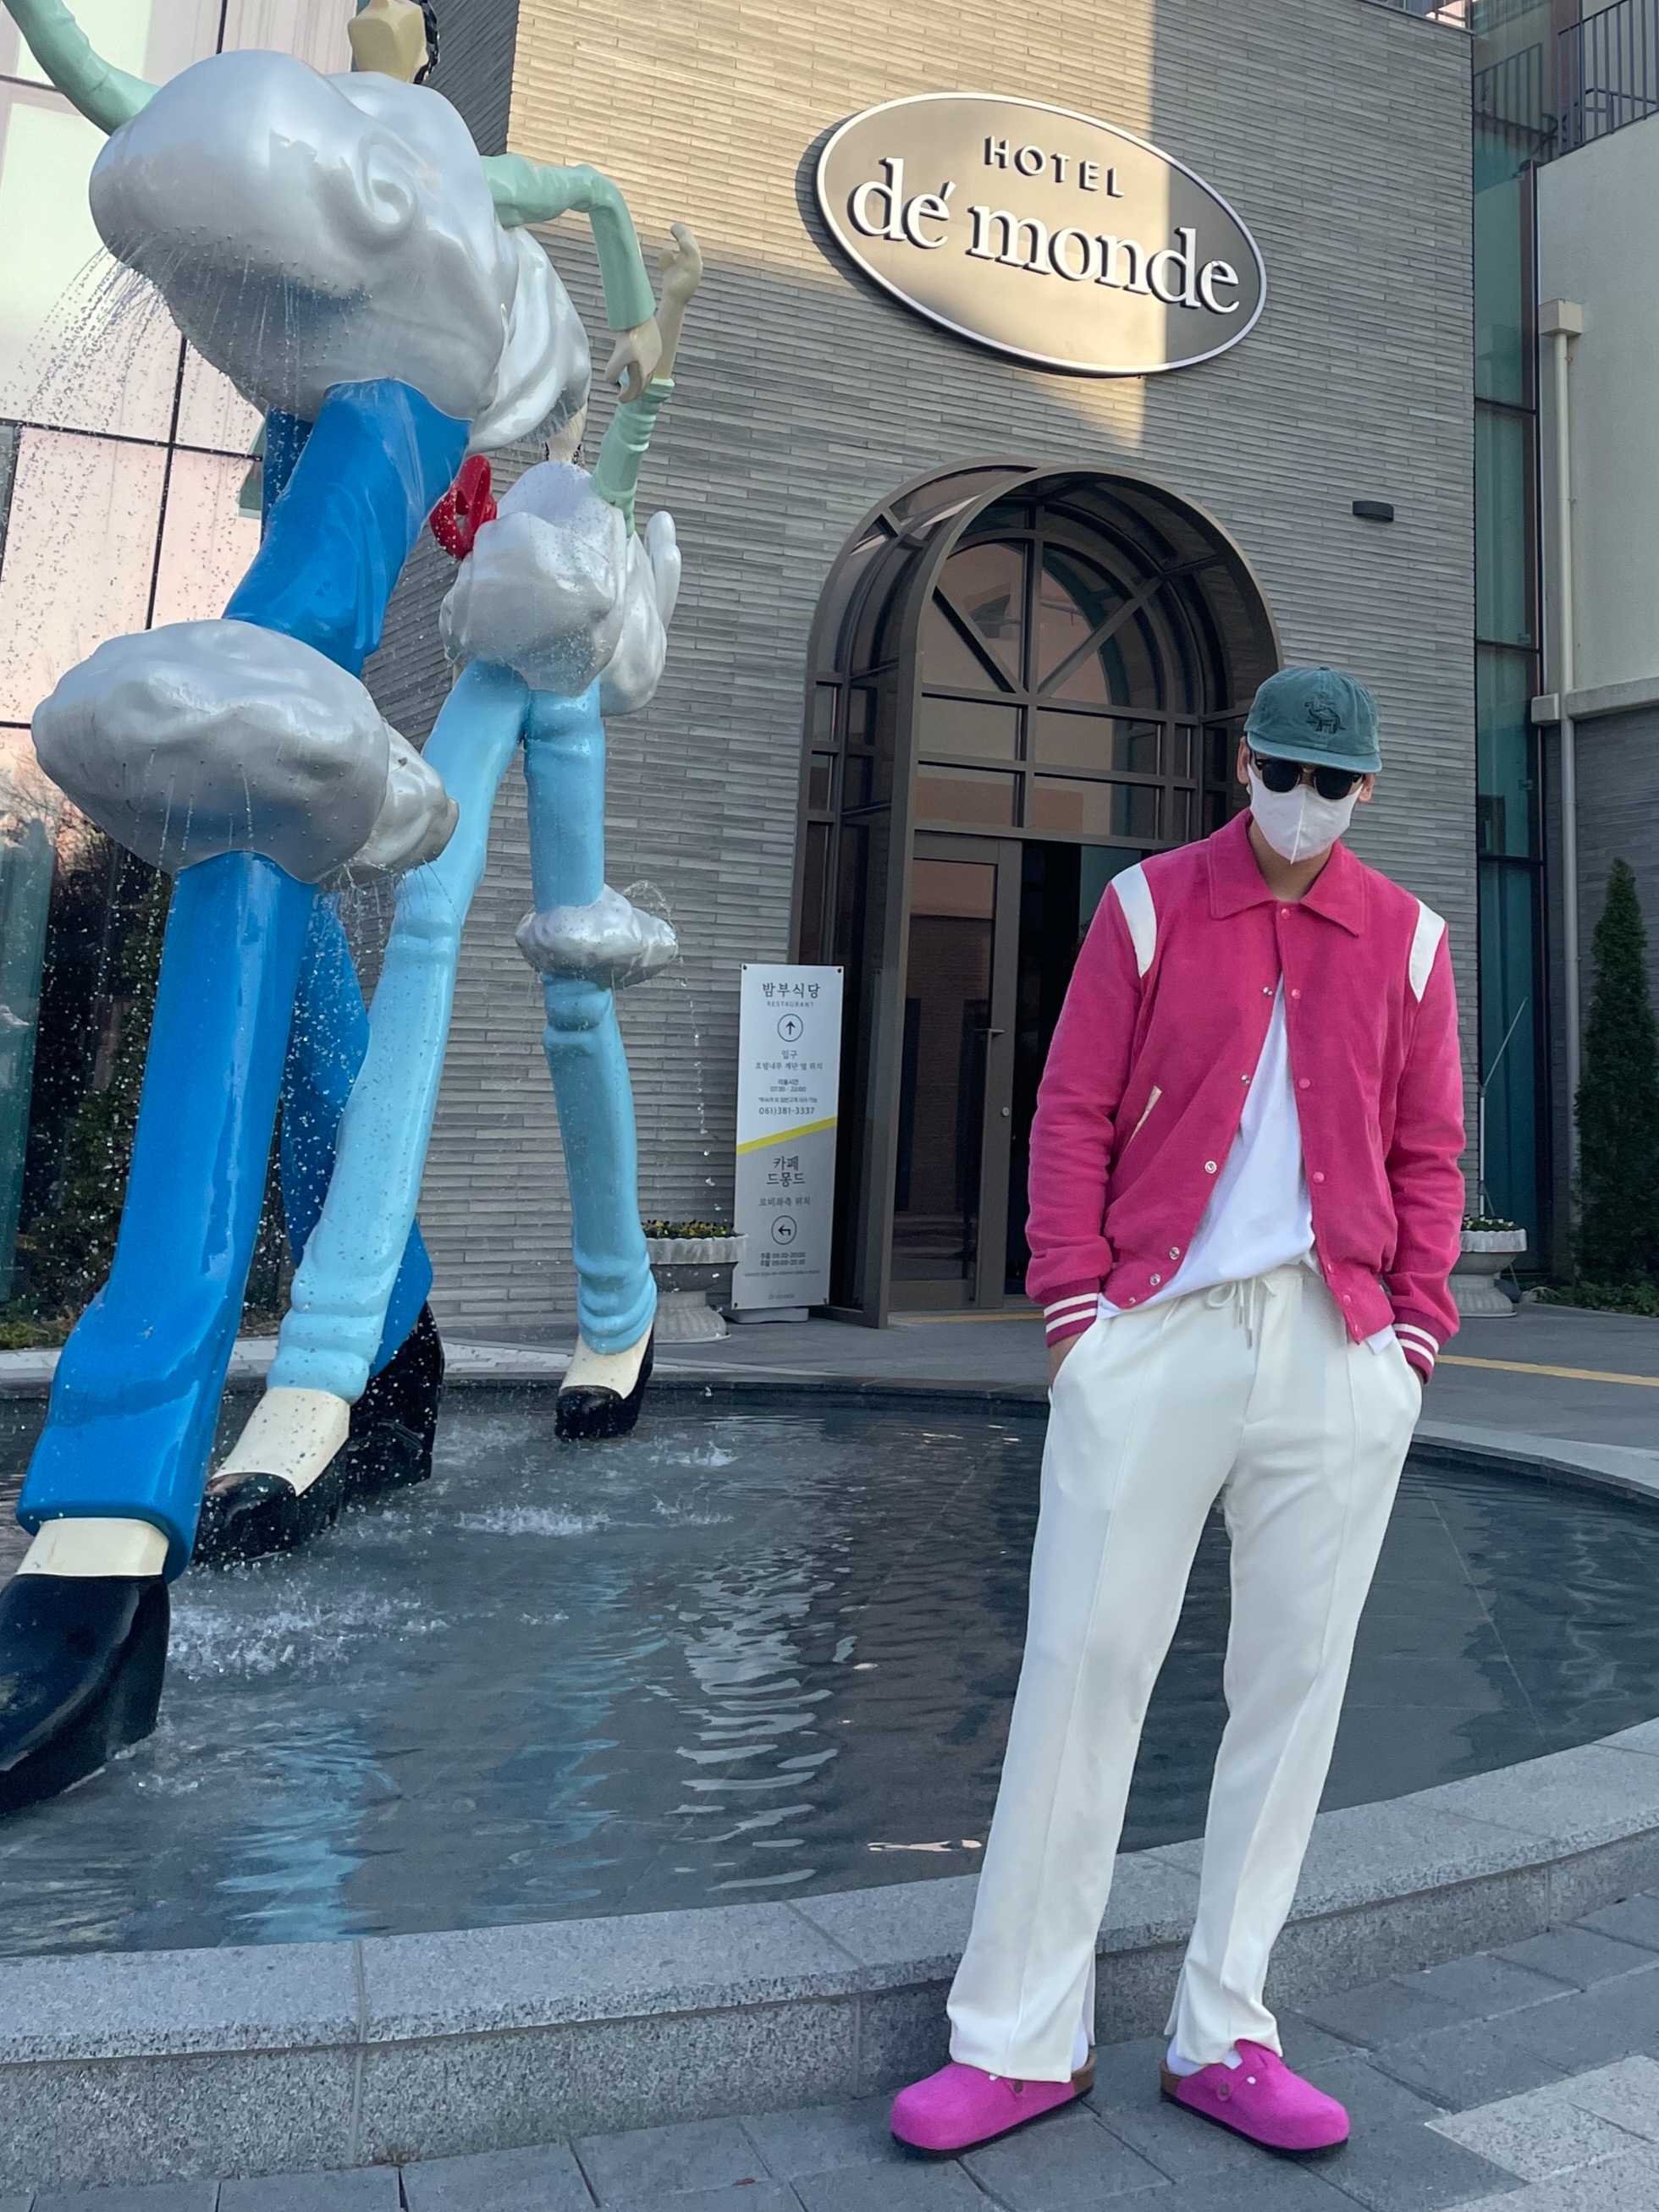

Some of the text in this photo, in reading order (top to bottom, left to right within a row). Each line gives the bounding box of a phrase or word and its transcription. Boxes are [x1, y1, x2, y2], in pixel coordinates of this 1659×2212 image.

[984, 135, 1125, 199] HOTEL
[965, 205, 1240, 315] monde
[763, 982, 821, 999] 밤부식당
[781, 1049, 798, 1059] 입구
[758, 1106, 815, 1115] 061)381-3337
[773, 1155, 799, 1171] 카페
[766, 1172, 806, 1187] 드몽드
